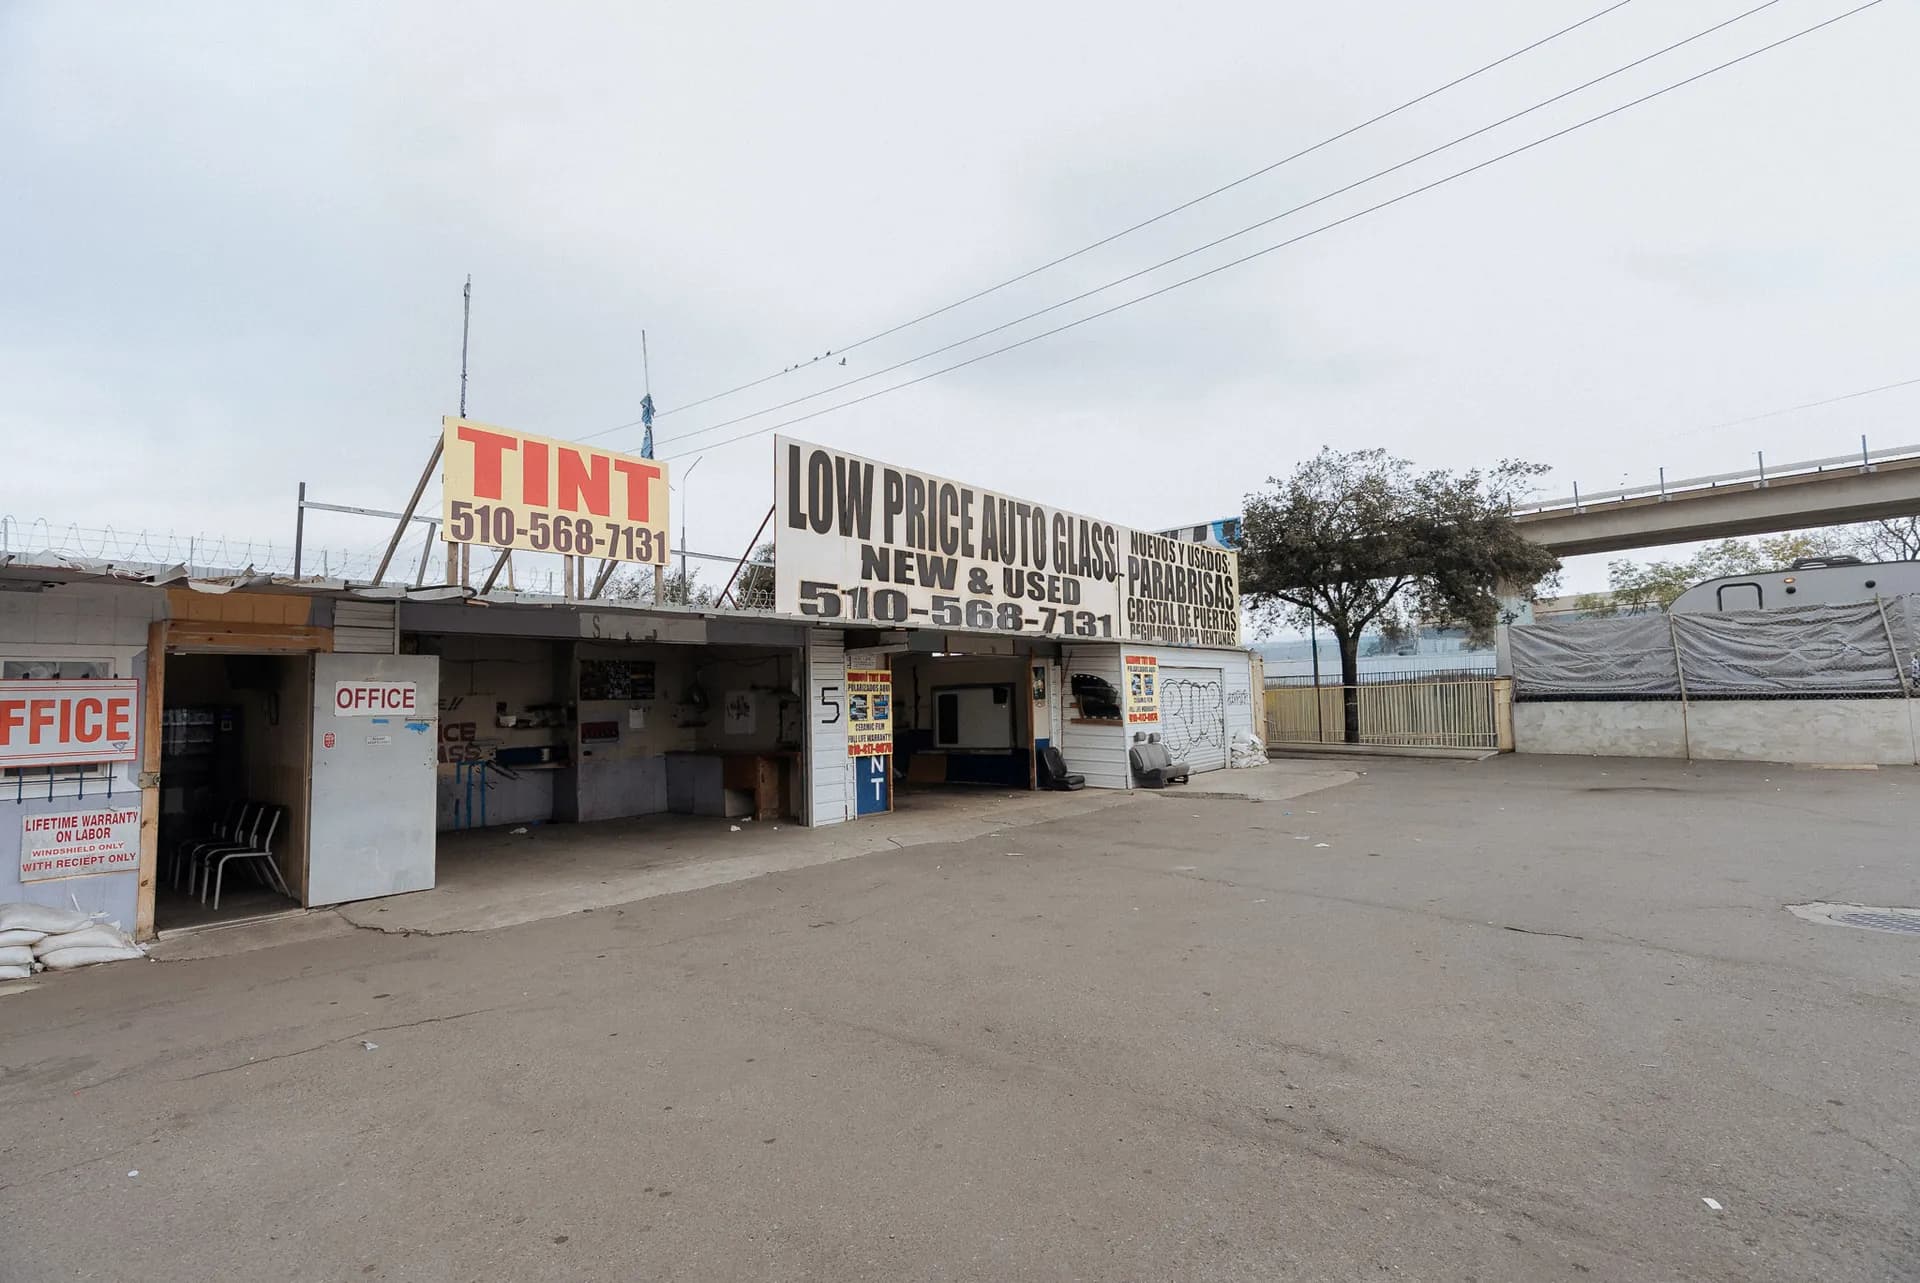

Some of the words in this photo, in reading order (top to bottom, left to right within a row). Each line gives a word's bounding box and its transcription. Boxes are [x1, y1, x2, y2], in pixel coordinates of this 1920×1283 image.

[458, 426, 660, 523] TINT
[451, 500, 665, 563] 510-568-7131
[788, 444, 874, 540] LOW
[883, 468, 974, 558] PRICE
[981, 494, 1047, 571] AUTO
[1053, 511, 1116, 583] GLASS
[1130, 530, 1175, 563] NUEVOS
[1178, 542, 1184, 565] Y
[1187, 545, 1231, 574] USADOS:
[860, 544, 958, 590] NEW
[967, 567, 993, 595] &
[1003, 567, 1081, 605] USED
[1128, 555, 1234, 611] PARABRISAS
[800, 580, 1112, 638] 510-568-7131
[1127, 597, 1176, 625] CRISTAL
[1178, 604, 1191, 627] DE
[1193, 606, 1237, 632] PUERTAS
[336, 687, 415, 709] OFFICE
[821, 687, 840, 724] 5
[0, 698, 130, 745] FFICE
[25, 816, 78, 832] LIFETIME
[82, 811, 138, 827] WARRANTY
[56, 831, 71, 842] ON
[75, 827, 111, 841] LABOR
[22, 861, 52, 872] WITH
[56, 856, 105, 868] RECIEPT
[108, 853, 136, 863] ONLY
[32, 845, 96, 857] WINDSHIELD
[98, 842, 124, 850] ONLY
